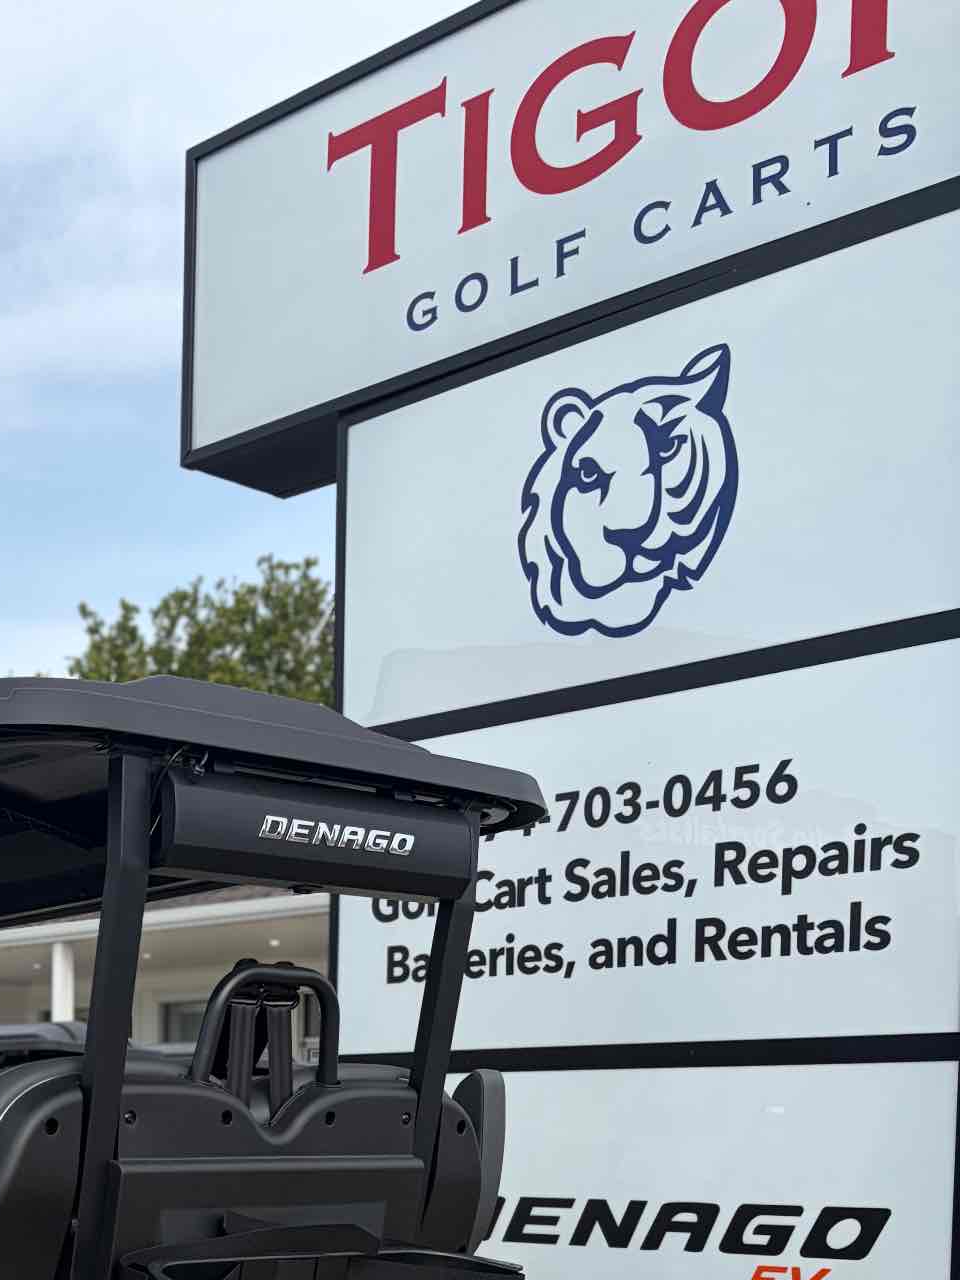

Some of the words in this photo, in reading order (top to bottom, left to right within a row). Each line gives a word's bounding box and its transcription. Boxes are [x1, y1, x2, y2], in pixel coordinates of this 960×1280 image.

[406, 228, 586, 332] GOLF
[633, 106, 917, 245] CARTS
[259, 814, 415, 856] DENAGO
[472, 867, 553, 912] Cart
[563, 850, 698, 903] Sales,
[713, 822, 921, 896] Repairs
[386, 932, 576, 986] Baeries,
[588, 917, 678, 971] and
[694, 900, 892, 963] Rentals
